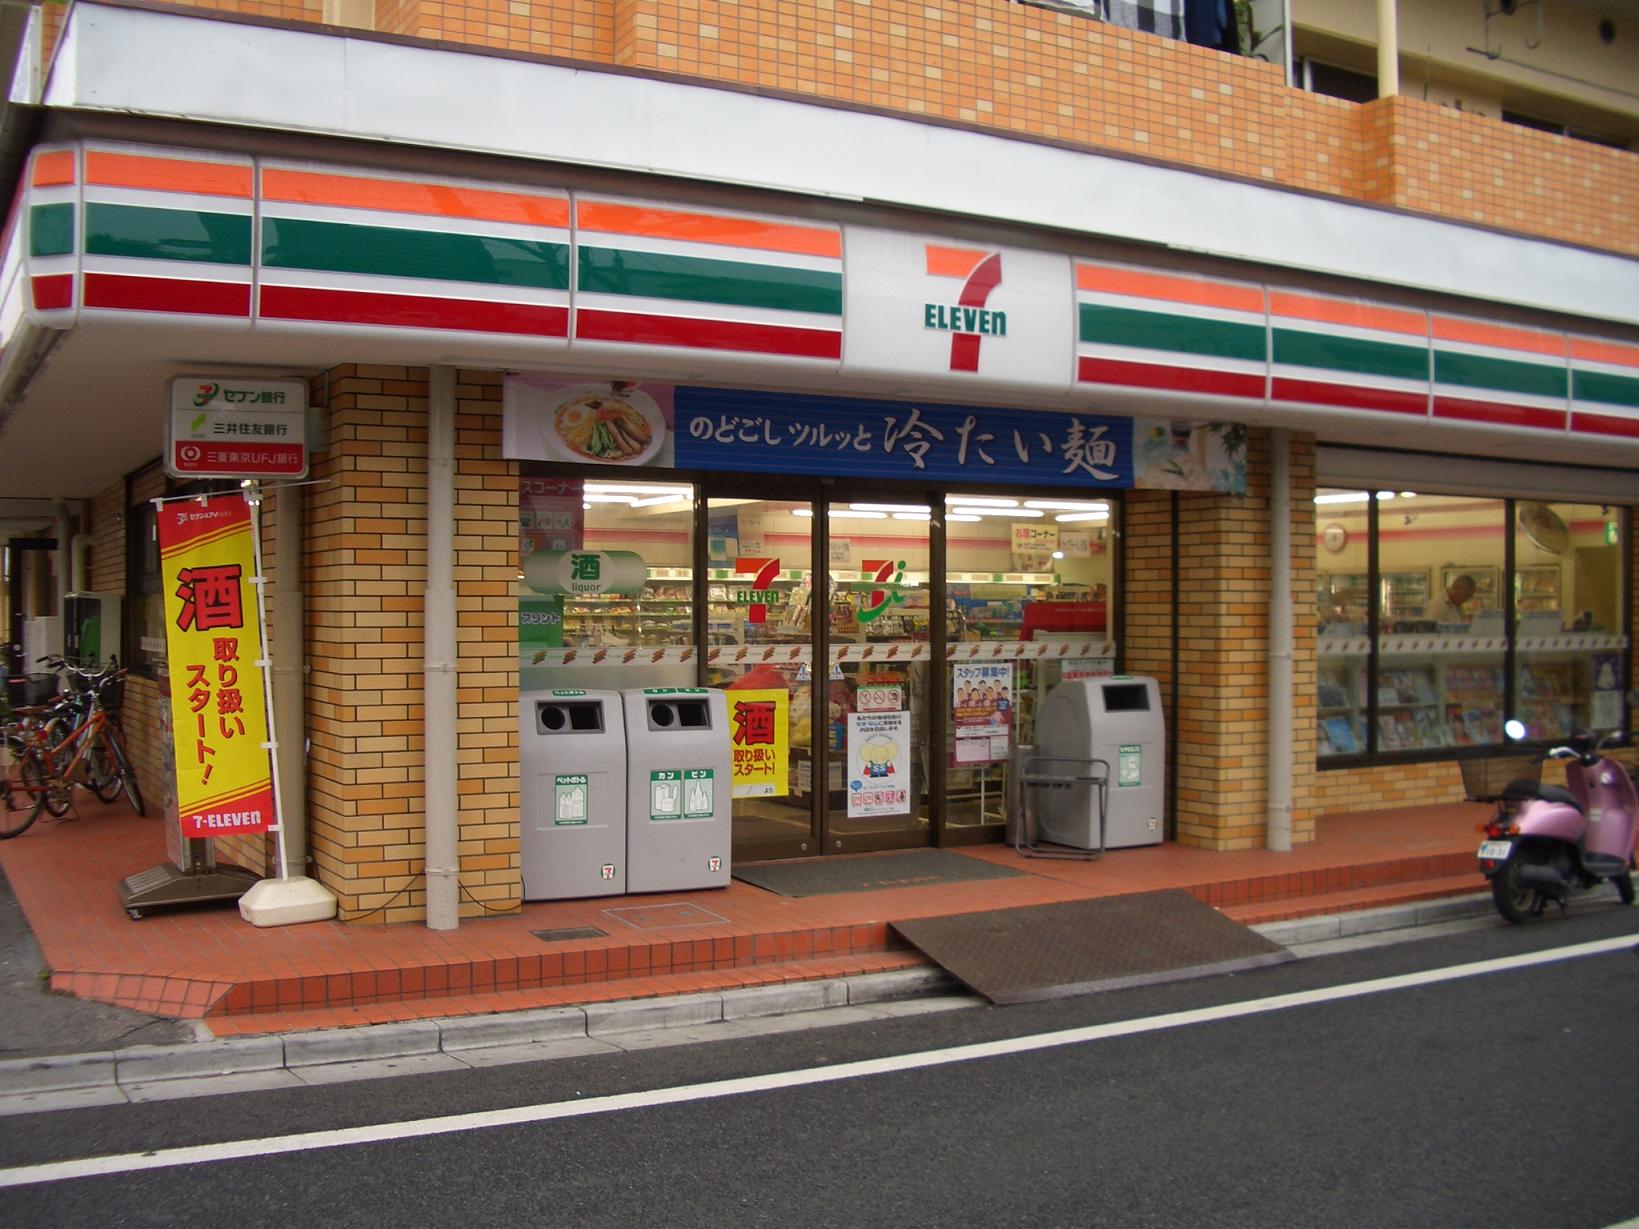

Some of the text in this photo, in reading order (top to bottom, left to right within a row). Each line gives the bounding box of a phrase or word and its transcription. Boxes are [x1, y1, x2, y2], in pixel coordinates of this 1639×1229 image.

[223, 388, 286, 405] セブン銀行
[213, 422, 288, 437] 三井住友銀行
[883, 408, 1120, 481] 冷たい麺
[206, 451, 298, 465] 三菱東京UFJ銀行
[570, 553, 602, 581] 酒
[571, 582, 602, 592] liquor
[175, 564, 245, 632] 酒
[213, 637, 246, 739] 取り扱い
[733, 700, 776, 746] 酒
[733, 748, 776, 762] 取り扱い
[658, 771, 675, 780] カン
